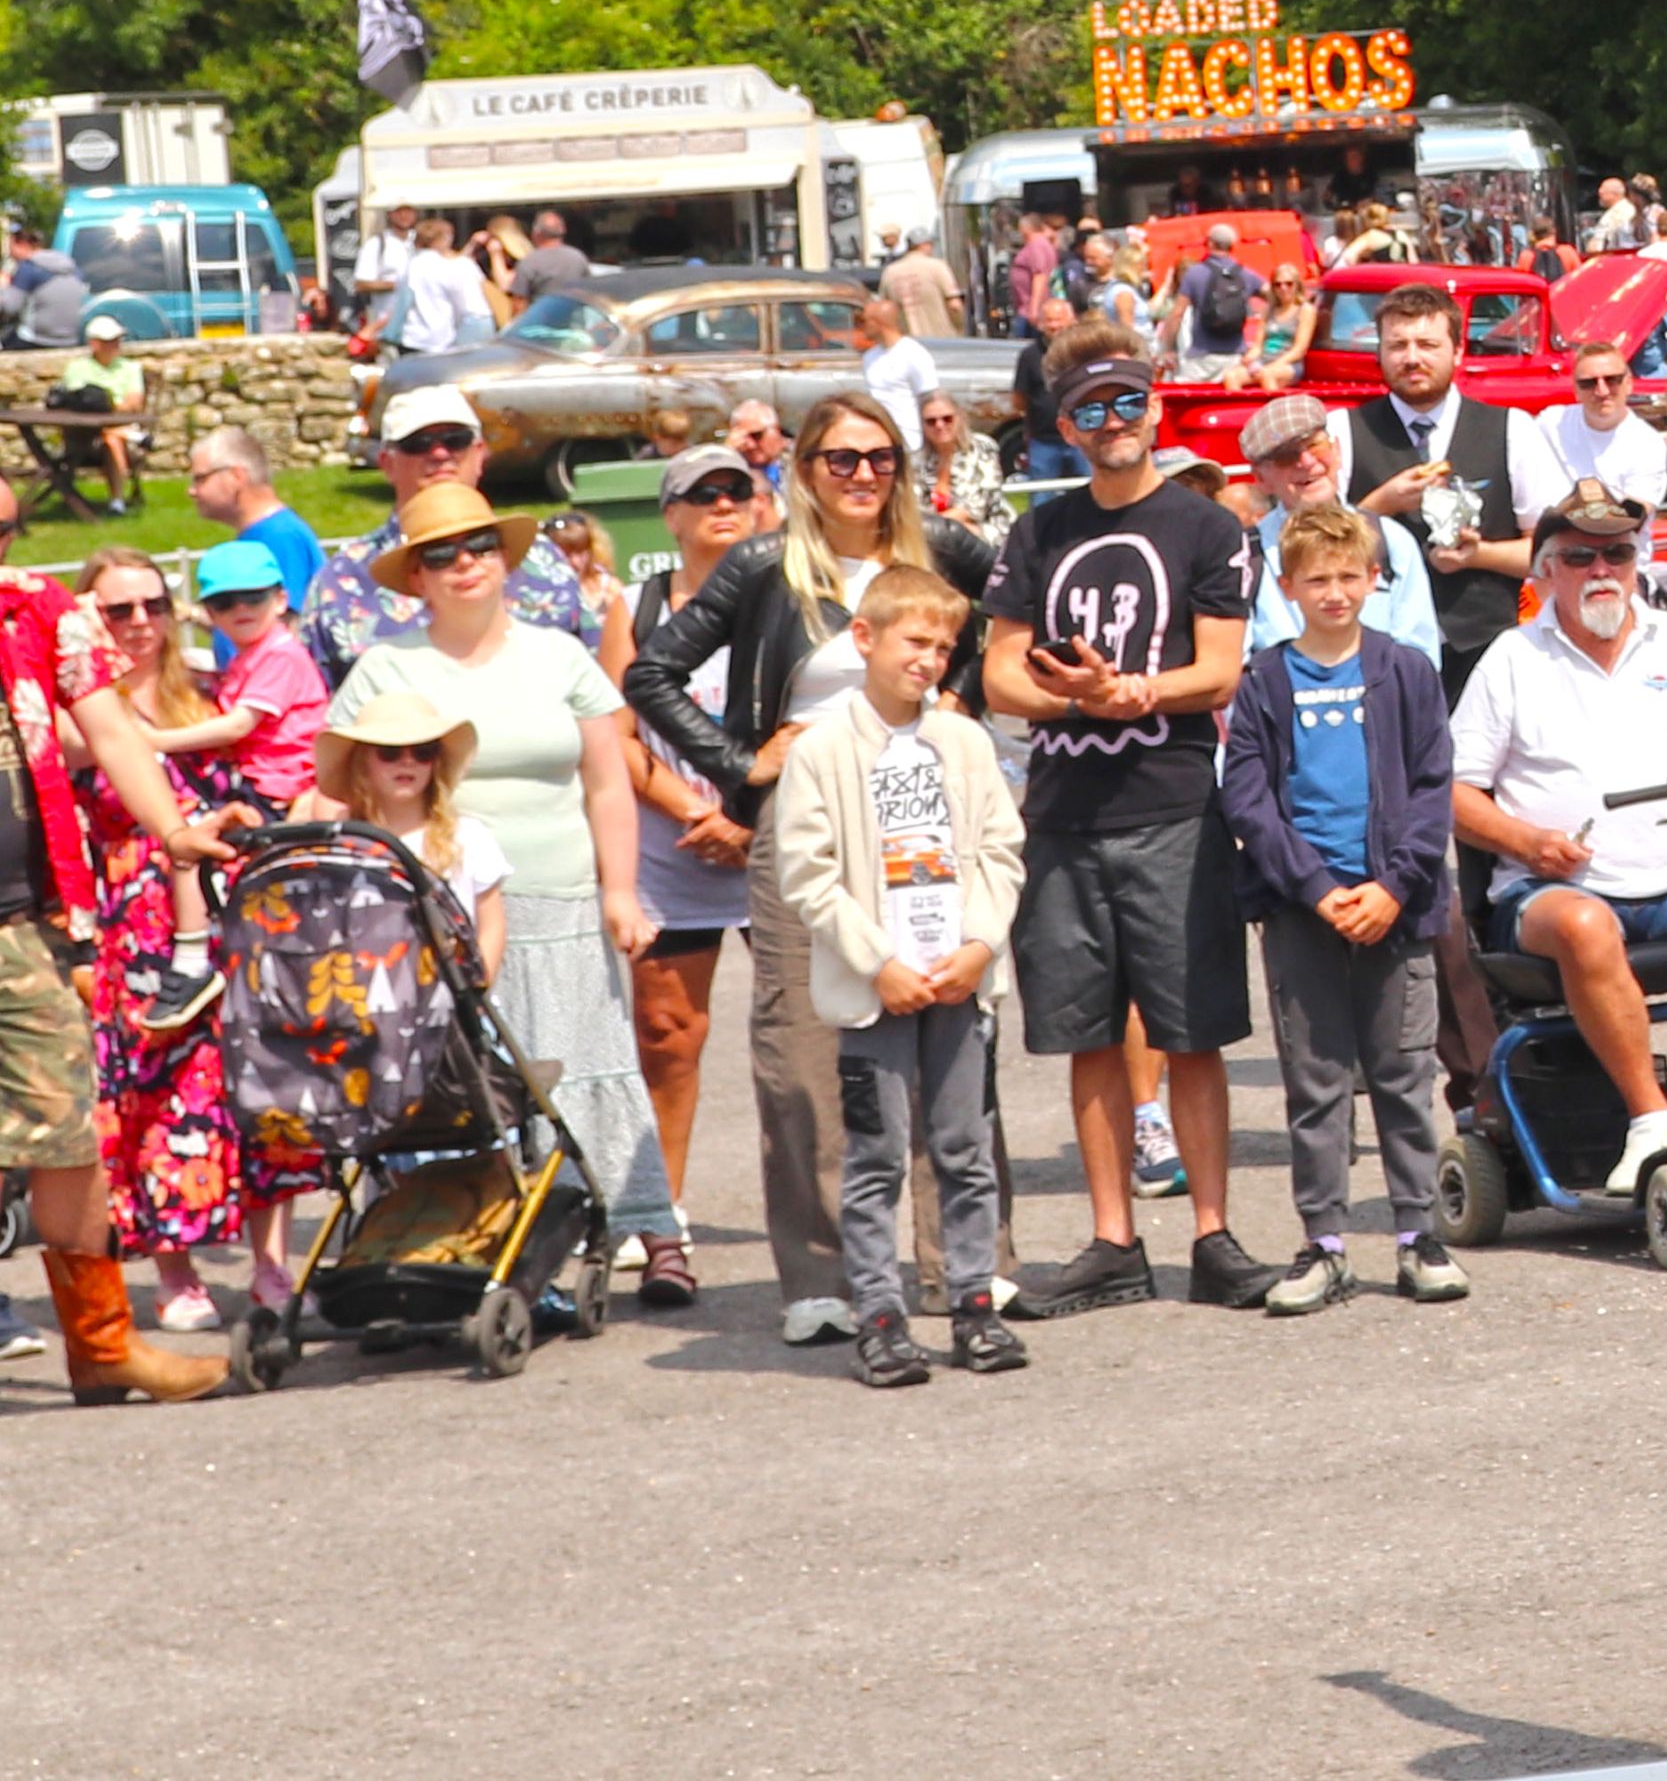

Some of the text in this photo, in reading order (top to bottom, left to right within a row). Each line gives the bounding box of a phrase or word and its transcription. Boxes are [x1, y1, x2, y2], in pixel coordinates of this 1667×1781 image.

[473, 83, 709, 116] LE CAFÉ CRÊPERIE
[1093, 28, 1416, 125] NACHOS
